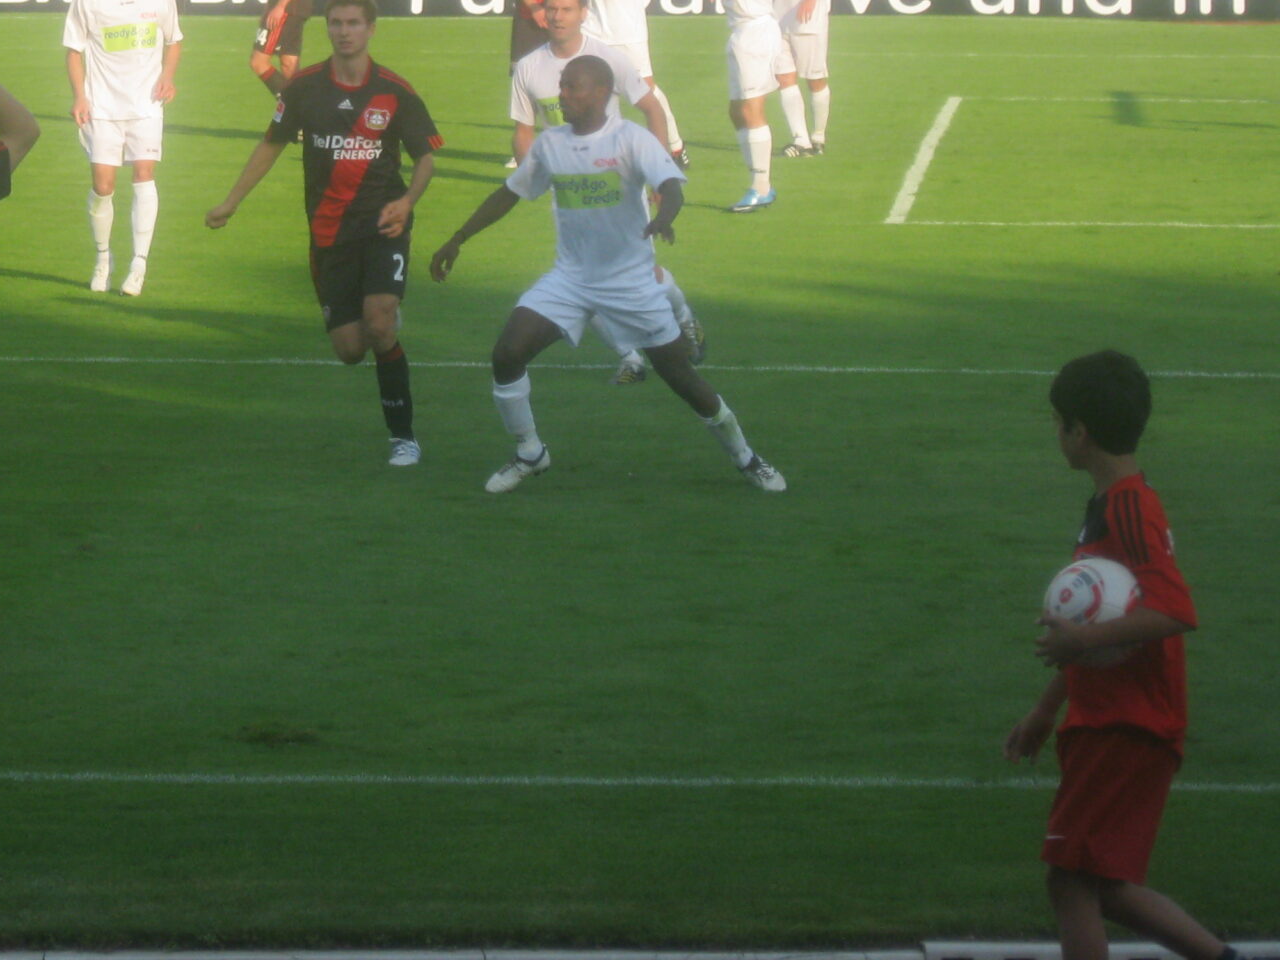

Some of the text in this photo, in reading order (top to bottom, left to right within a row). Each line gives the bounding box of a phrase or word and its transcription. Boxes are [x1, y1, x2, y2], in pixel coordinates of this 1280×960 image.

[312, 134, 382, 149] TelDaFax
[333, 149, 383, 160] ENERGY
[391, 253, 405, 282] 2
